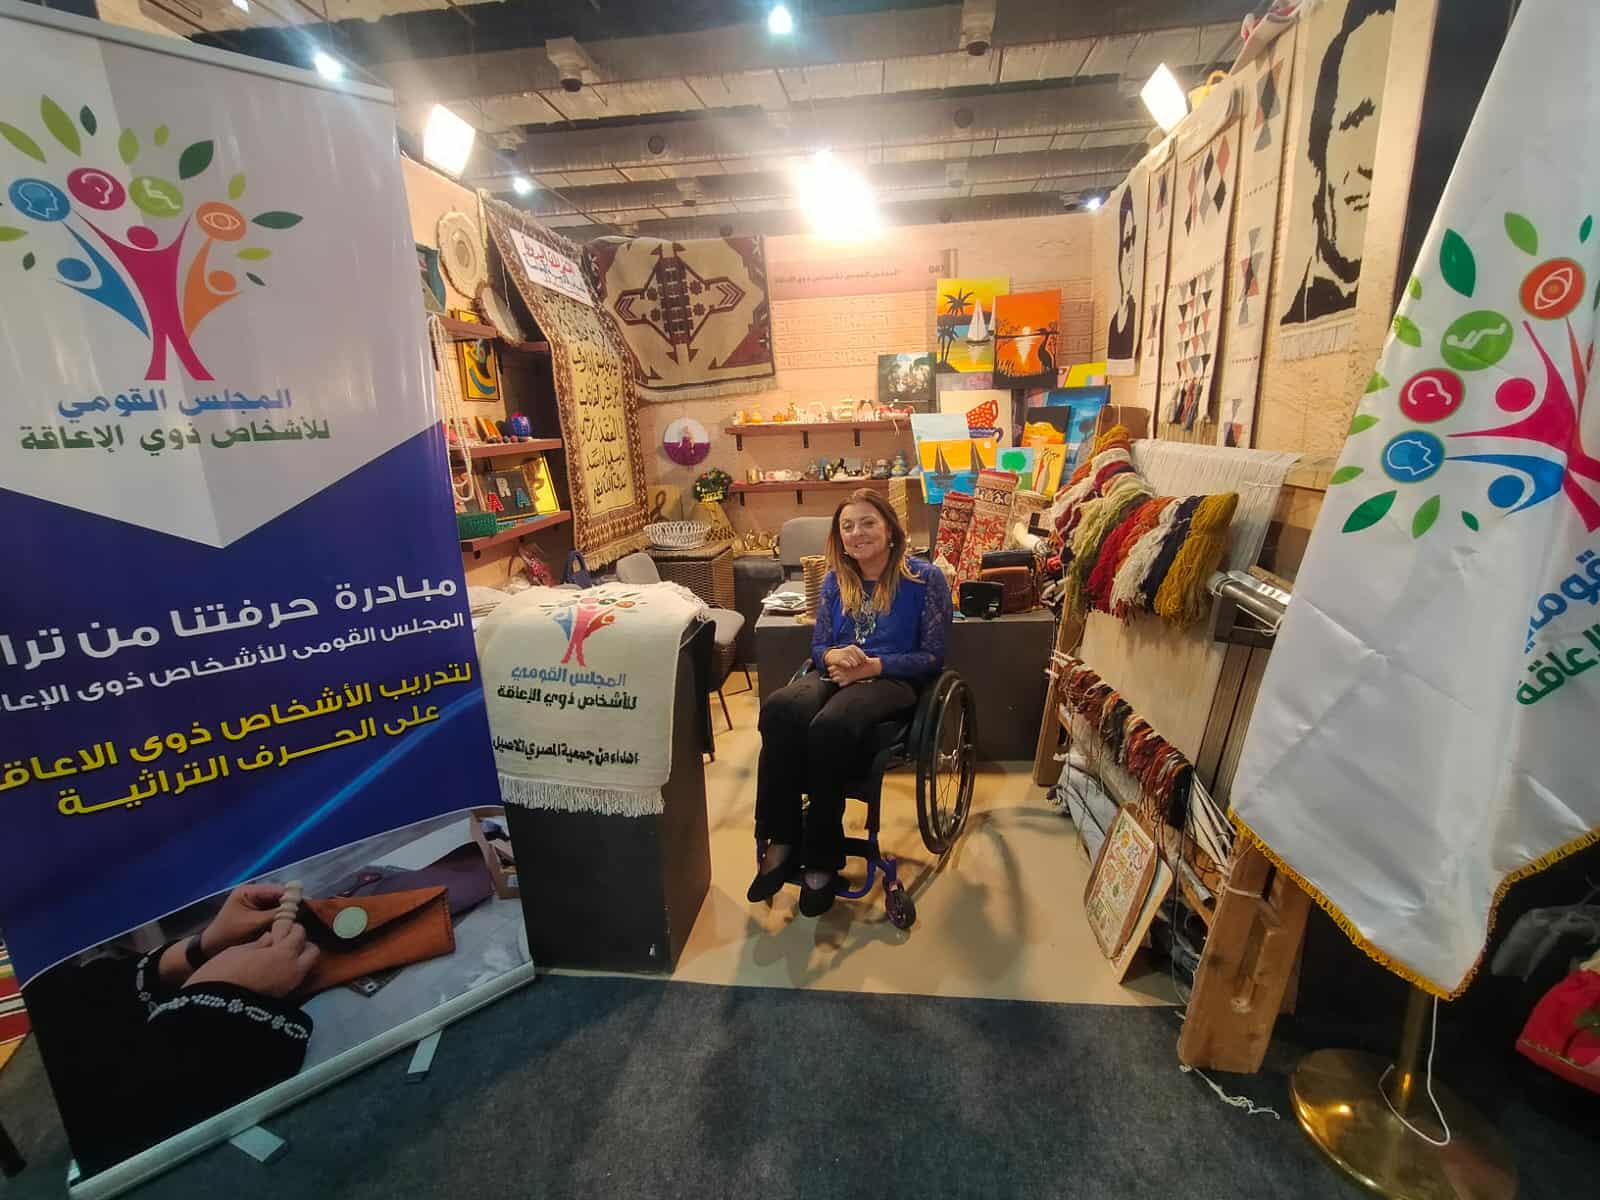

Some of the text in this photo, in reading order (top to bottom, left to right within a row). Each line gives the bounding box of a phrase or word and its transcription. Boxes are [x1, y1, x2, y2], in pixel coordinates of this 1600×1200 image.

[58, 388, 292, 424] المجلس القومي
[20, 418, 331, 456] للأشخاص ذوي الإعاقة
[0, 575, 457, 670] مبادرة حرفتنا من ترا
[380, 612, 464, 641] المجلس
[150, 643, 287, 687] للأشخاص
[379, 662, 472, 700] لتدريب
[569, 671, 626, 689] المجلس
[0, 684, 69, 712] الإعا
[221, 681, 371, 740] الأشخاص
[384, 703, 440, 736] على
[0, 740, 118, 791] الاعاق
